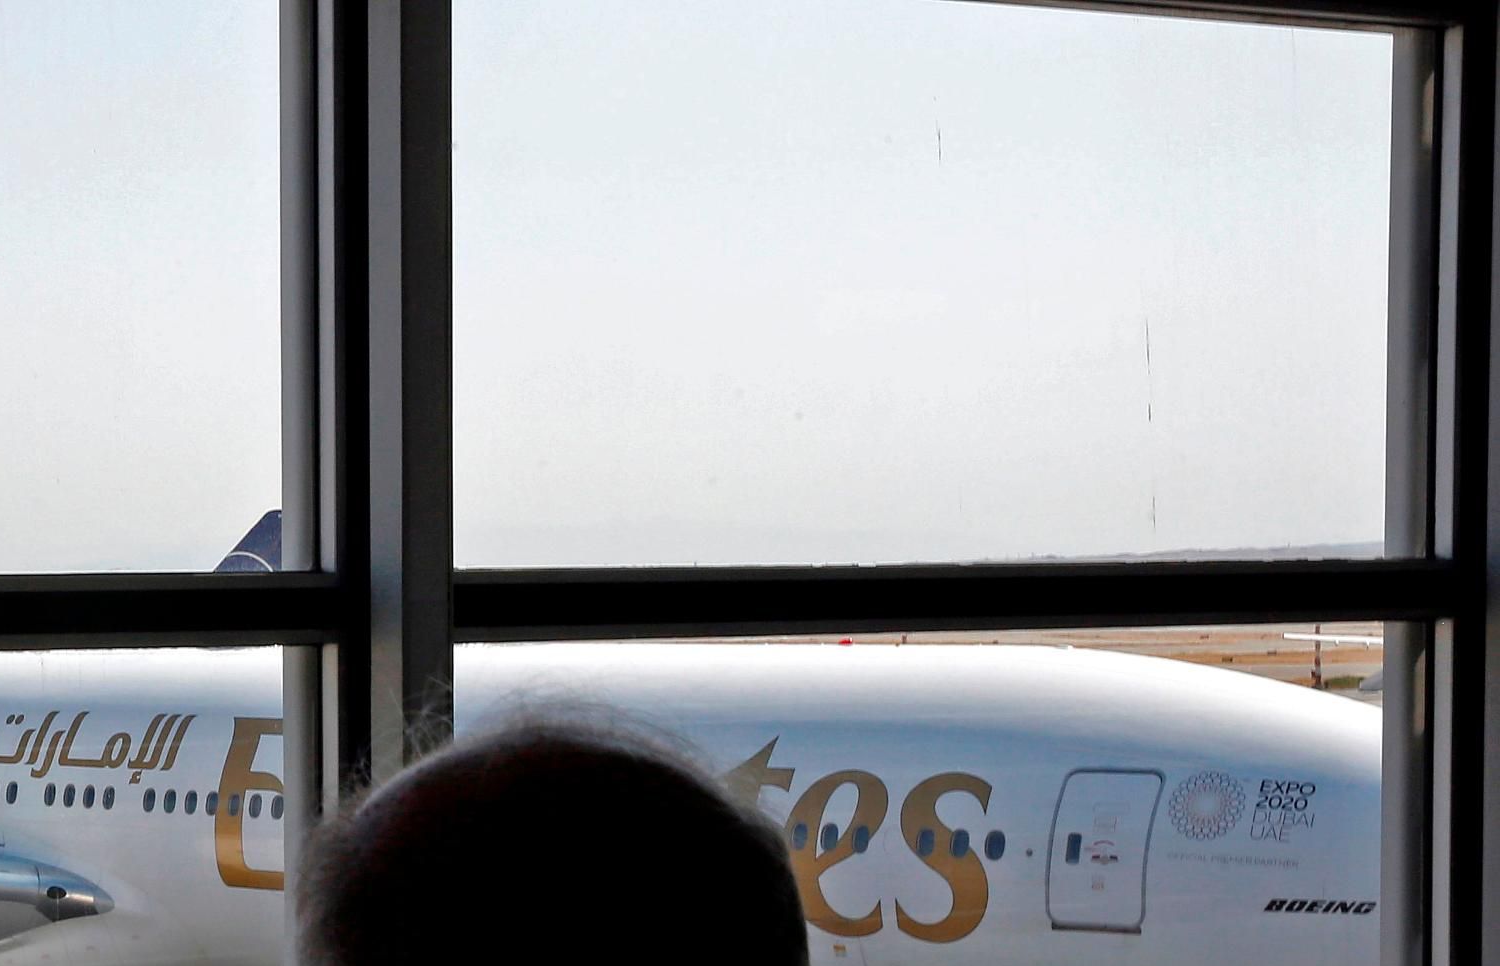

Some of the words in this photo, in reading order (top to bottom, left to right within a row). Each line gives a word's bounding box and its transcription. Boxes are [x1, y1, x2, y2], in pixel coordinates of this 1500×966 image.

[1259, 779, 1316, 797] EXPO
[1256, 795, 1308, 812] 2020
[1251, 809, 1315, 829] DUBAI
[1250, 825, 1291, 843] UAE
[1264, 899, 1377, 915] BOEING
